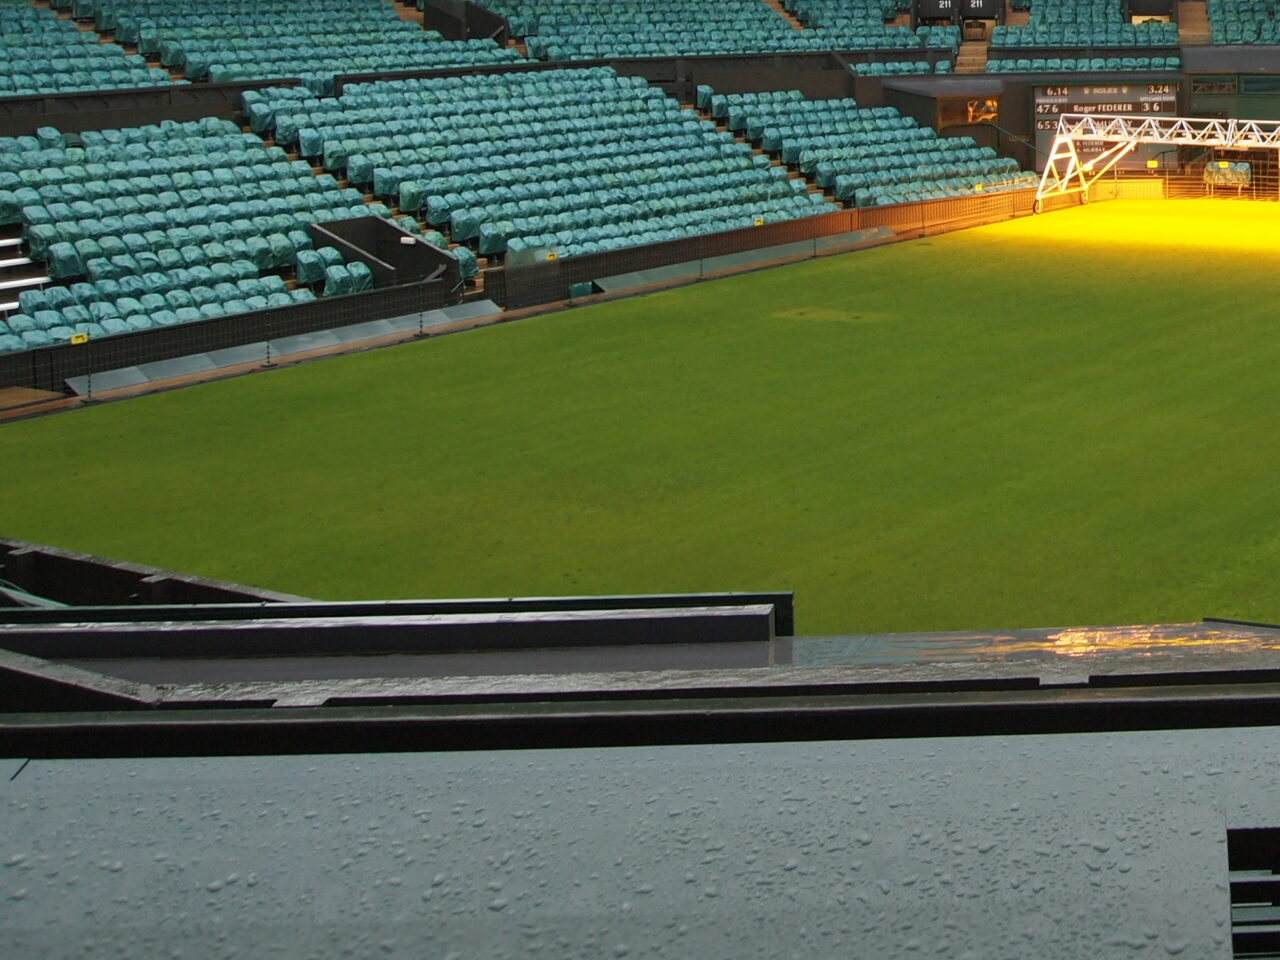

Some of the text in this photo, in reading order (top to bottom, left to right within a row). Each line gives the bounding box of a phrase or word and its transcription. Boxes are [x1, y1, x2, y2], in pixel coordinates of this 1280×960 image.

[939, 0, 952, 9] 211
[970, 0, 983, 8] 211
[1047, 87, 1069, 95] 6.14
[1148, 85, 1169, 94] 3.24
[1073, 104, 1096, 114] Roger
[1097, 103, 1133, 112] FEDERER
